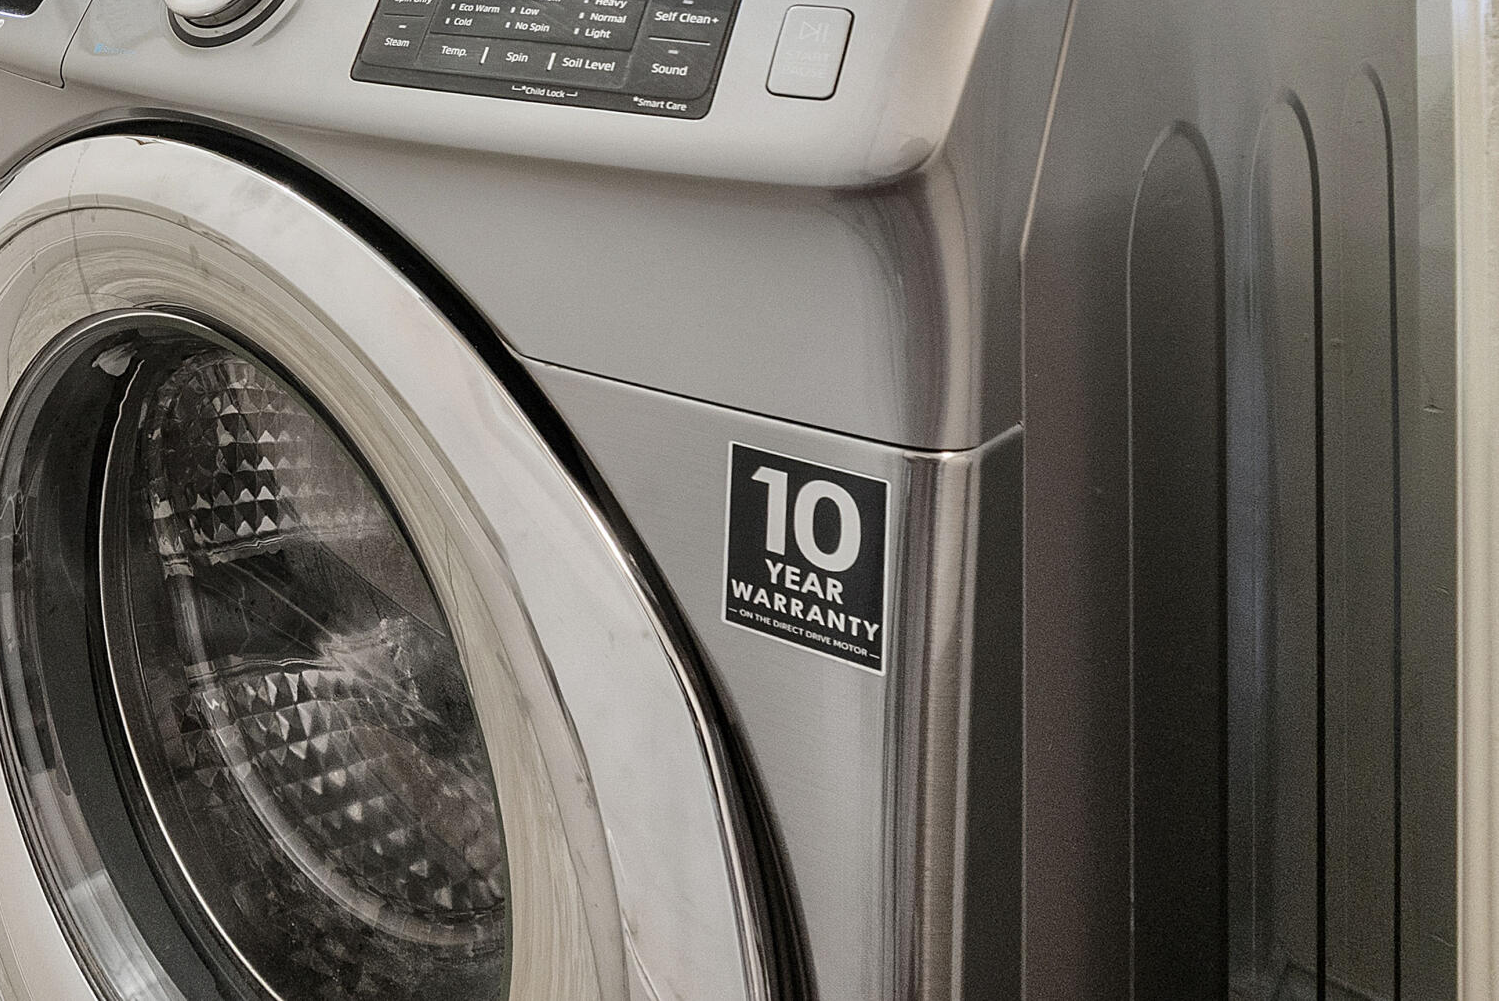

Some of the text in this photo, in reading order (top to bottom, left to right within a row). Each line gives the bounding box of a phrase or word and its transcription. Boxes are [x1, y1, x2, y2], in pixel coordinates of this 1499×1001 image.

[458, 3, 501, 13] Eco Warm
[519, 6, 540, 16] Low
[453, 17, 473, 26] Cold
[590, 12, 628, 24] Normal
[654, 10, 720, 25] Self Clean+
[514, 21, 550, 33] No Spin
[584, 28, 612, 40] Light
[384, 37, 410, 48] Steam
[441, 45, 468, 57] Temp.
[506, 51, 529, 63] Spin
[561, 57, 616, 72] Soil Level
[651, 63, 689, 77] Sound
[546, 88, 566, 98] Lock
[665, 100, 688, 112] Care
[751, 465, 862, 573] 10
[765, 558, 844, 605] YEAR
[731, 578, 880, 642] WARRANTY
[739, 608, 868, 657] ON THE DIRECT DRIVE MOTOR
